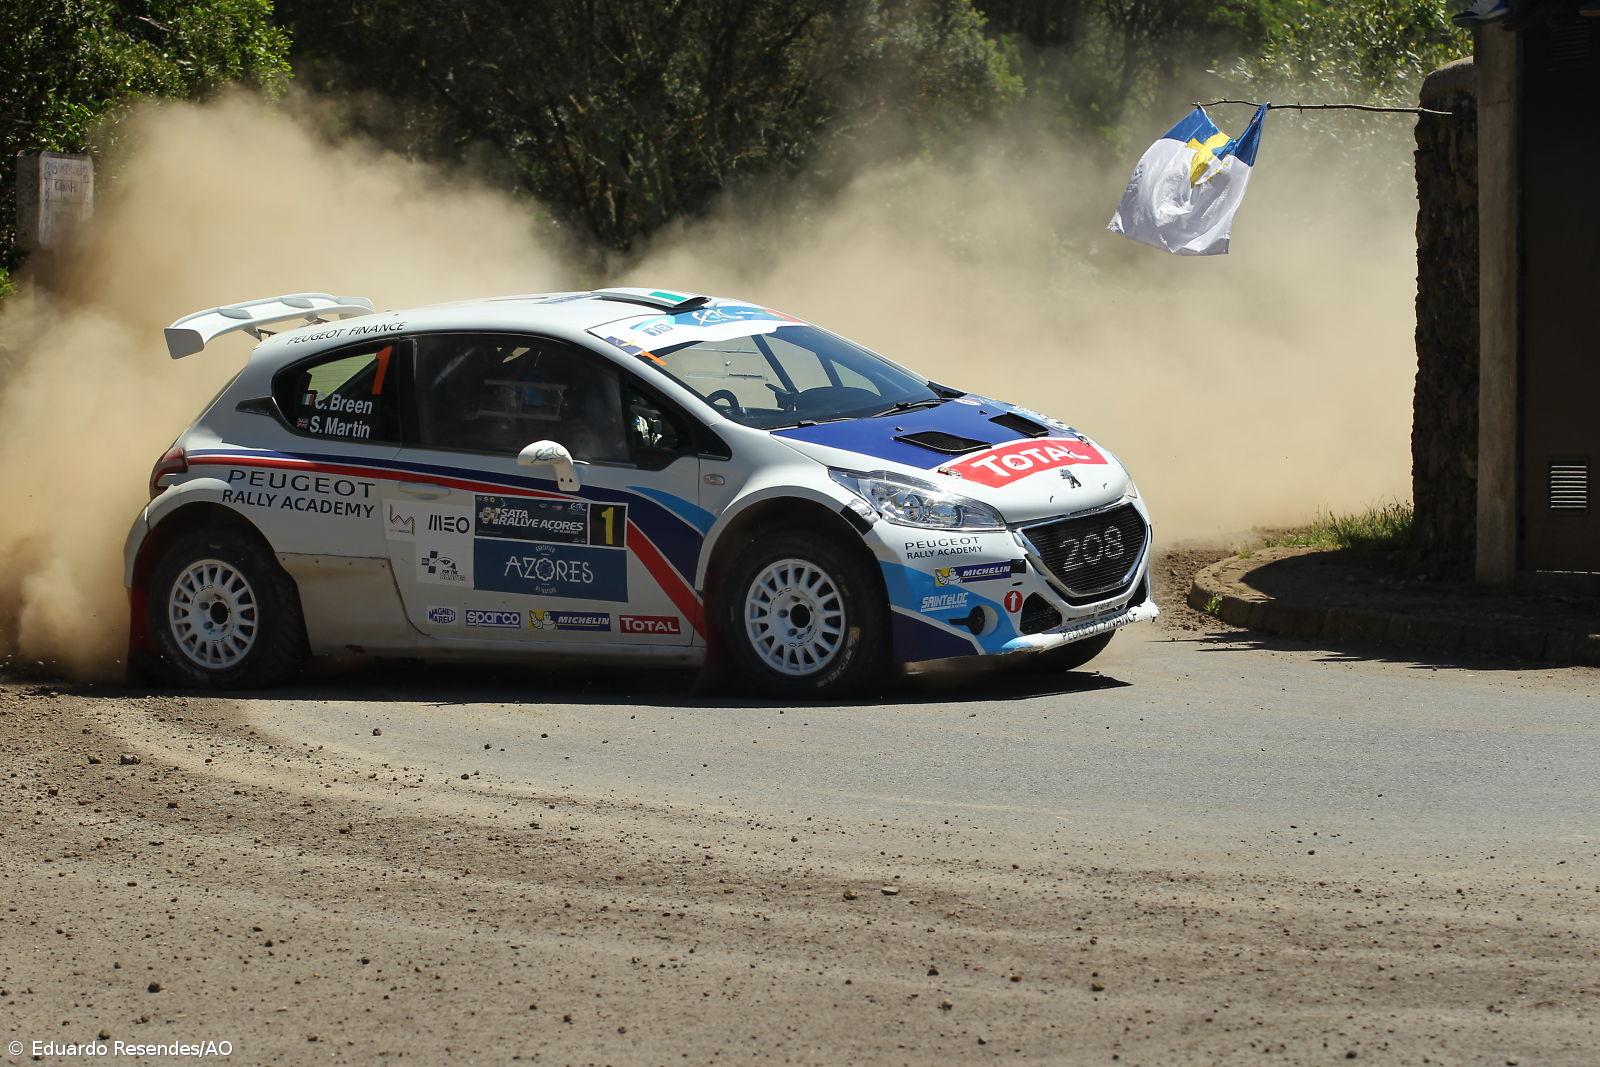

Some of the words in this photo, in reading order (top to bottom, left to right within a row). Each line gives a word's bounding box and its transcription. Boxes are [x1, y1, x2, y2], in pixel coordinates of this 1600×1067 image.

[286, 329, 345, 345] PEUGEOT
[351, 322, 407, 337] FINANCE
[371, 345, 393, 395] 1
[329, 394, 373, 415] Breen
[325, 417, 371, 439] Martin
[971, 445, 1092, 477] TOTAL
[227, 469, 376, 498] PEUGEOT
[222, 489, 278, 507] RALLY
[280, 497, 375, 519] ACADEMY
[500, 508, 528, 520] SATA
[428, 513, 470, 534] MEO
[499, 517, 538, 528] RALLYE
[540, 520, 584, 531] AÇORES
[601, 506, 614, 545] 1
[905, 536, 980, 550] PEUGEOT
[907, 549, 934, 560] RALLY
[937, 545, 983, 557] ACADEMY
[1059, 525, 1124, 572] 208
[504, 555, 594, 583] AZORES
[963, 565, 1011, 577] MICHELIN
[466, 611, 520, 626] sparco
[557, 615, 610, 625] MICHELIN
[621, 617, 679, 632] TOTAL
